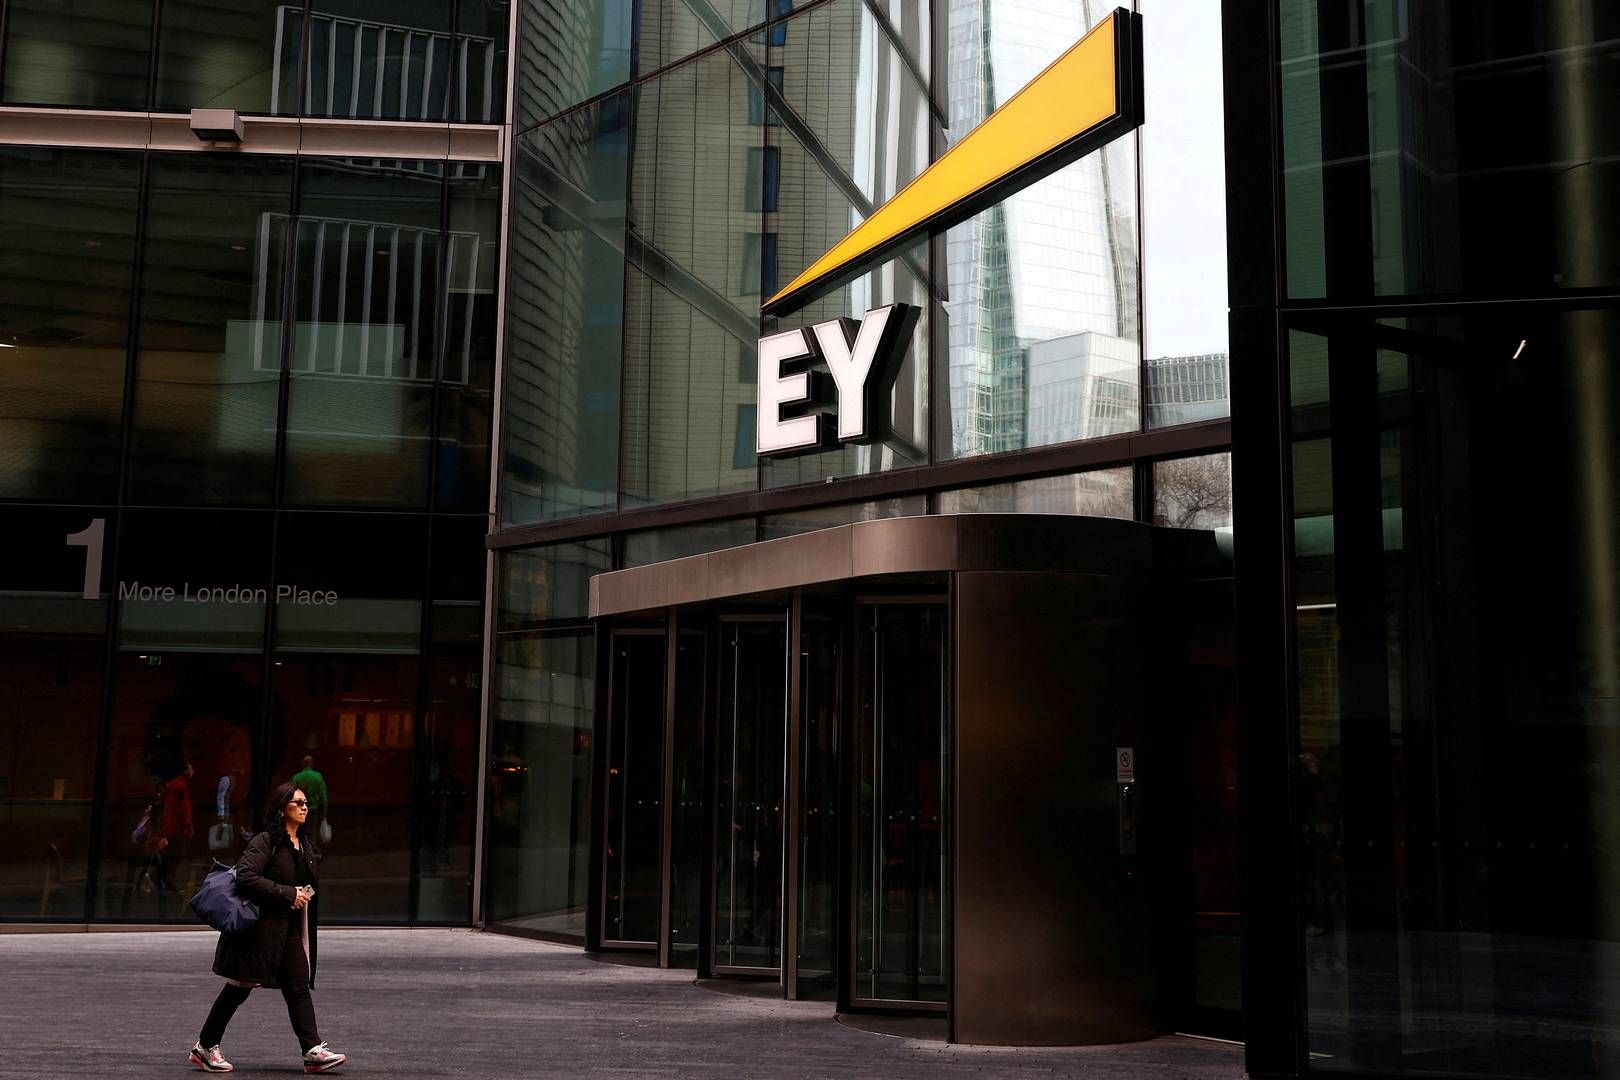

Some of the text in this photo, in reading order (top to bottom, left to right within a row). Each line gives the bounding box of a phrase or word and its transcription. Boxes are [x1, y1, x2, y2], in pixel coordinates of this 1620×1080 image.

[756, 304, 897, 456] EY
[66, 517, 338, 606] 1 More London Place
